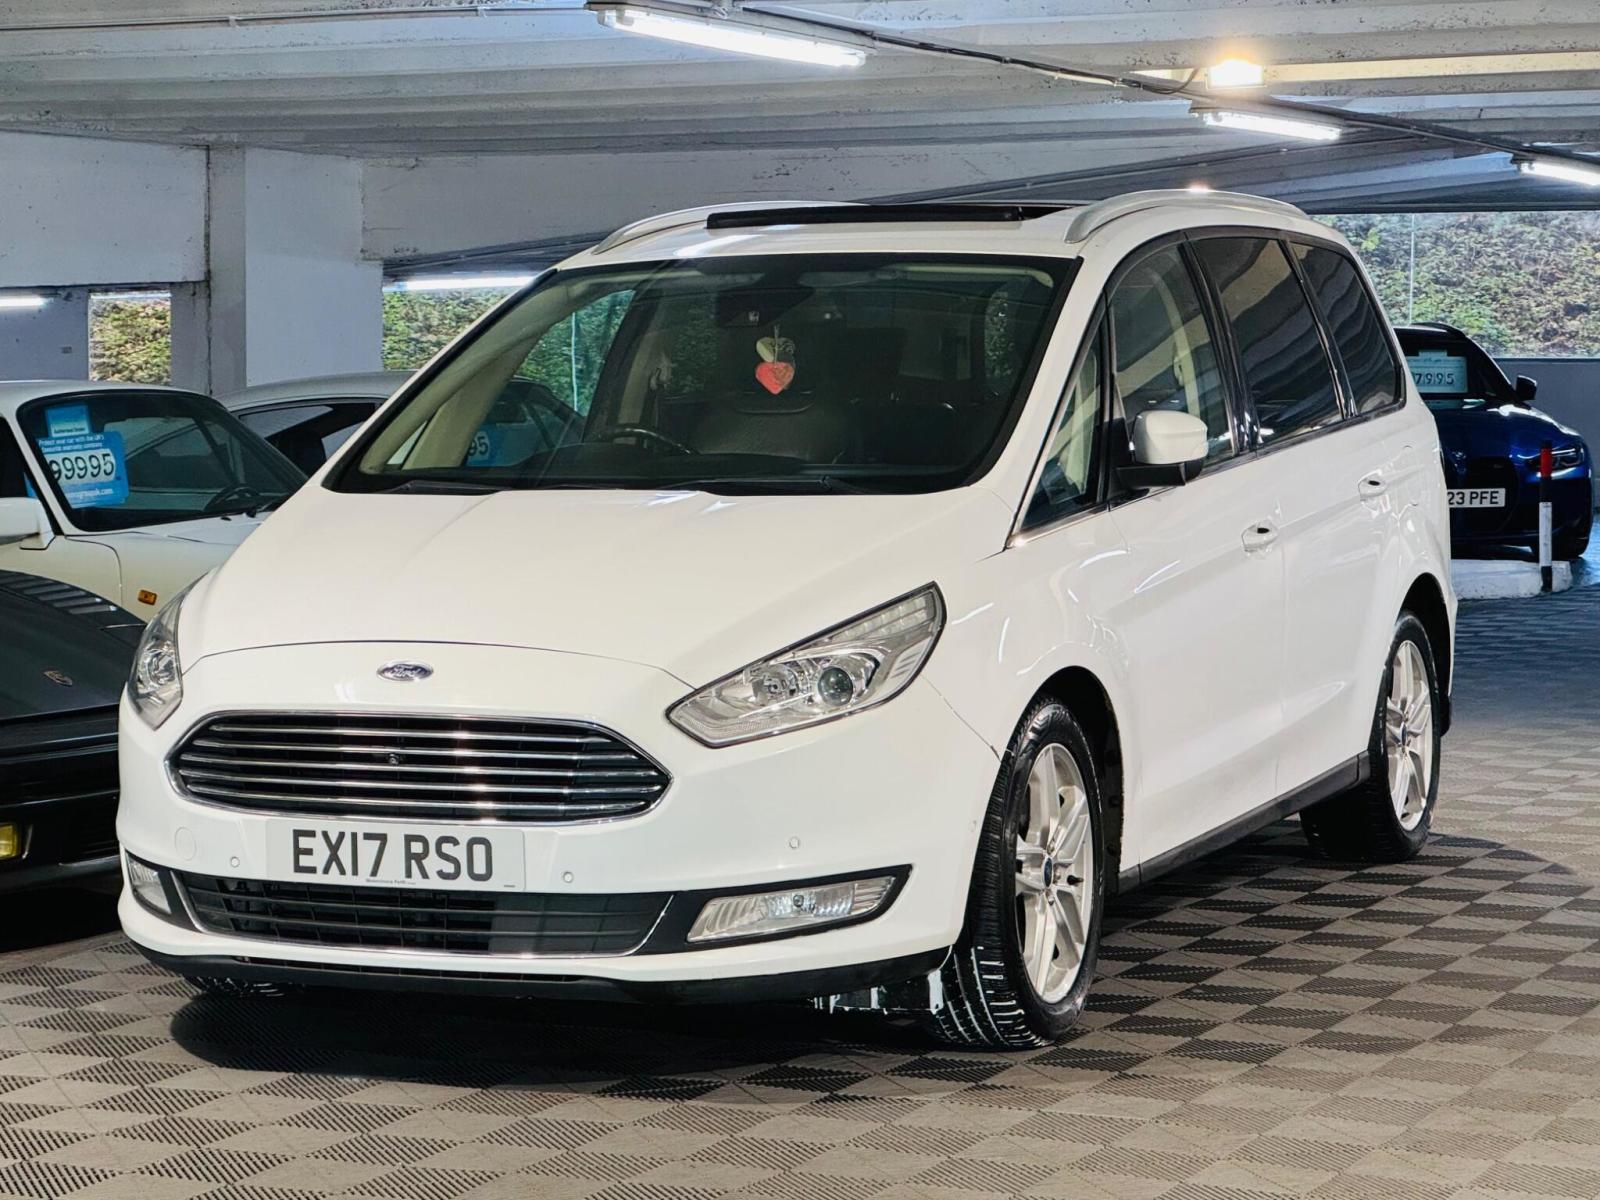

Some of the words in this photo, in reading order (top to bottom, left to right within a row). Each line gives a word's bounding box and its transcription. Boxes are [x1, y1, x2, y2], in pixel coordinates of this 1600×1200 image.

[1411, 372, 1455, 385] 7995
[1469, 490, 1499, 505] PFE
[292, 828, 388, 877] EX17
[403, 833, 493, 882] RSO
